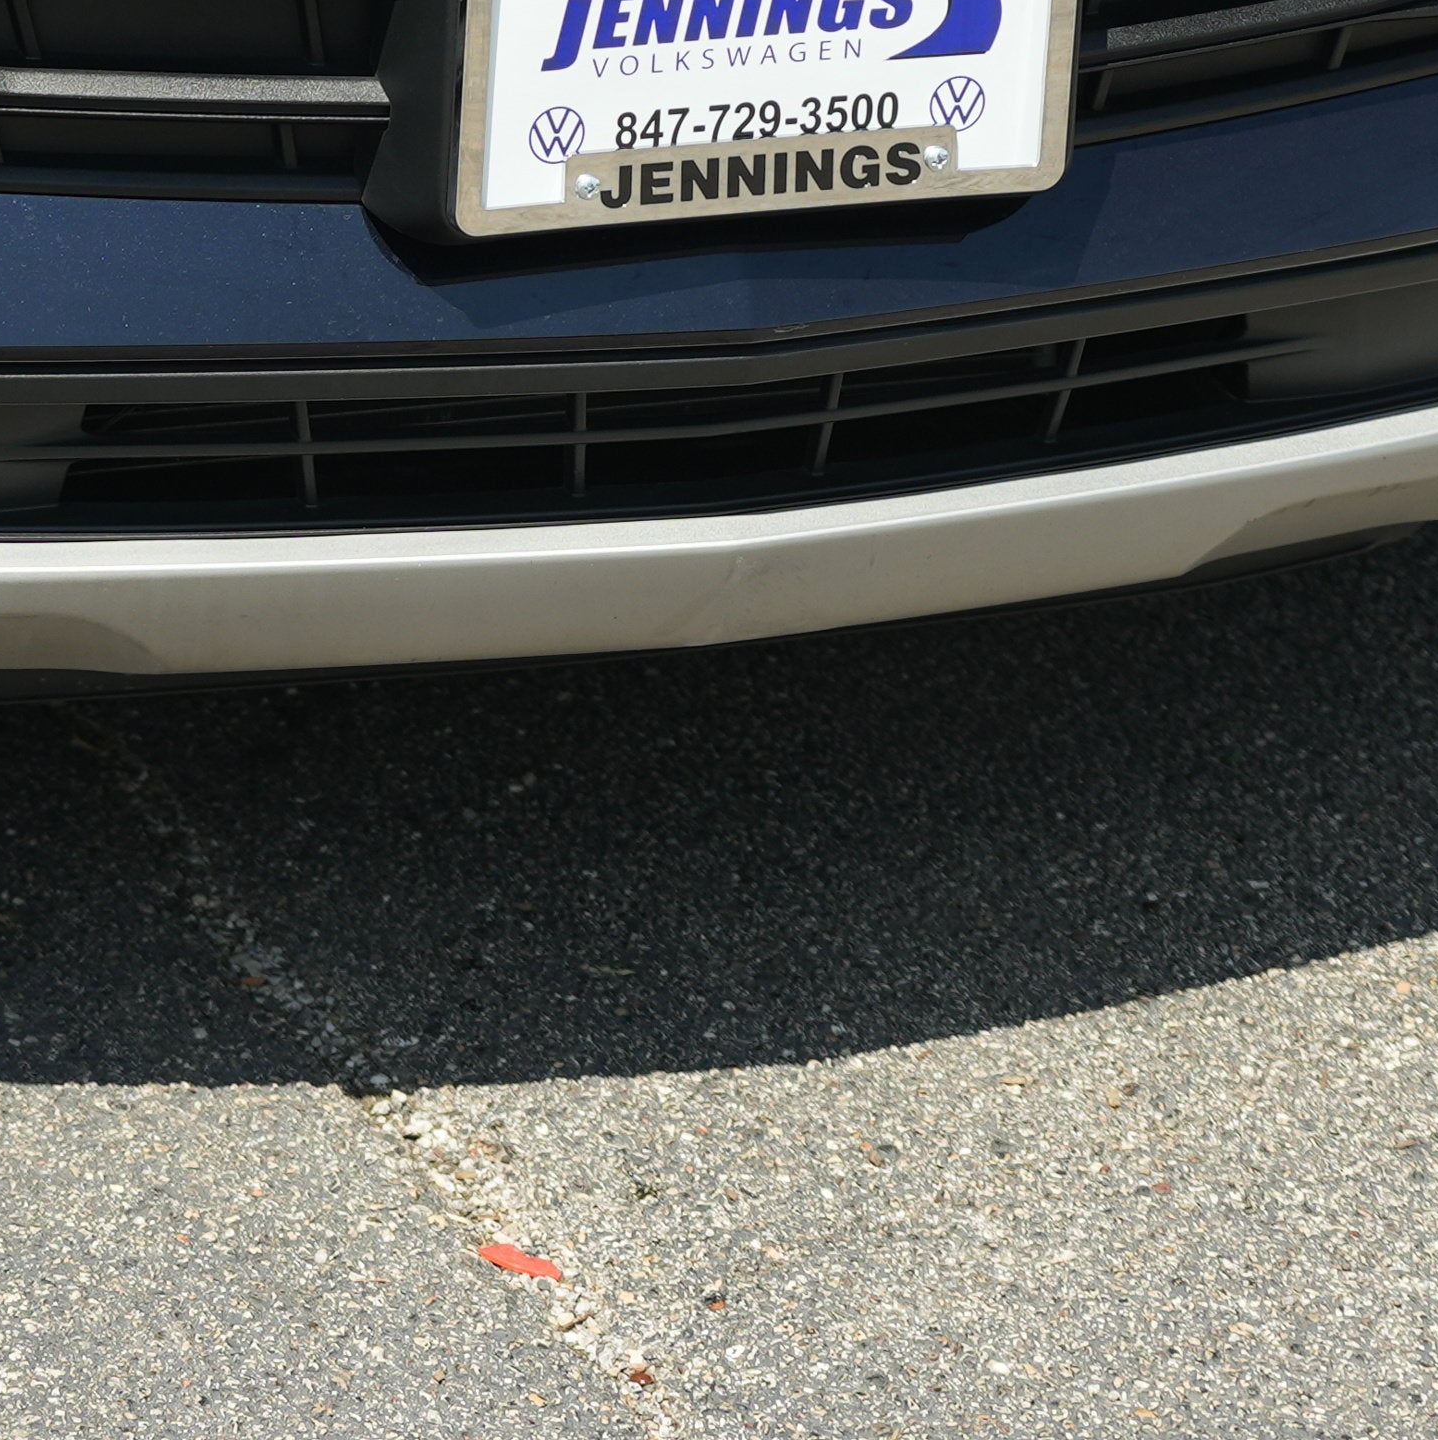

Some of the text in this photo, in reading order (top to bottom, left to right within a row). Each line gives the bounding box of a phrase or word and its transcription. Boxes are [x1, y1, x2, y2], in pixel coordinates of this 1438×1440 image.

[592, 39, 862, 77] VOLKSWAGEN
[615, 92, 899, 149] 847-729-3500
[600, 142, 922, 208] JENNINGS
